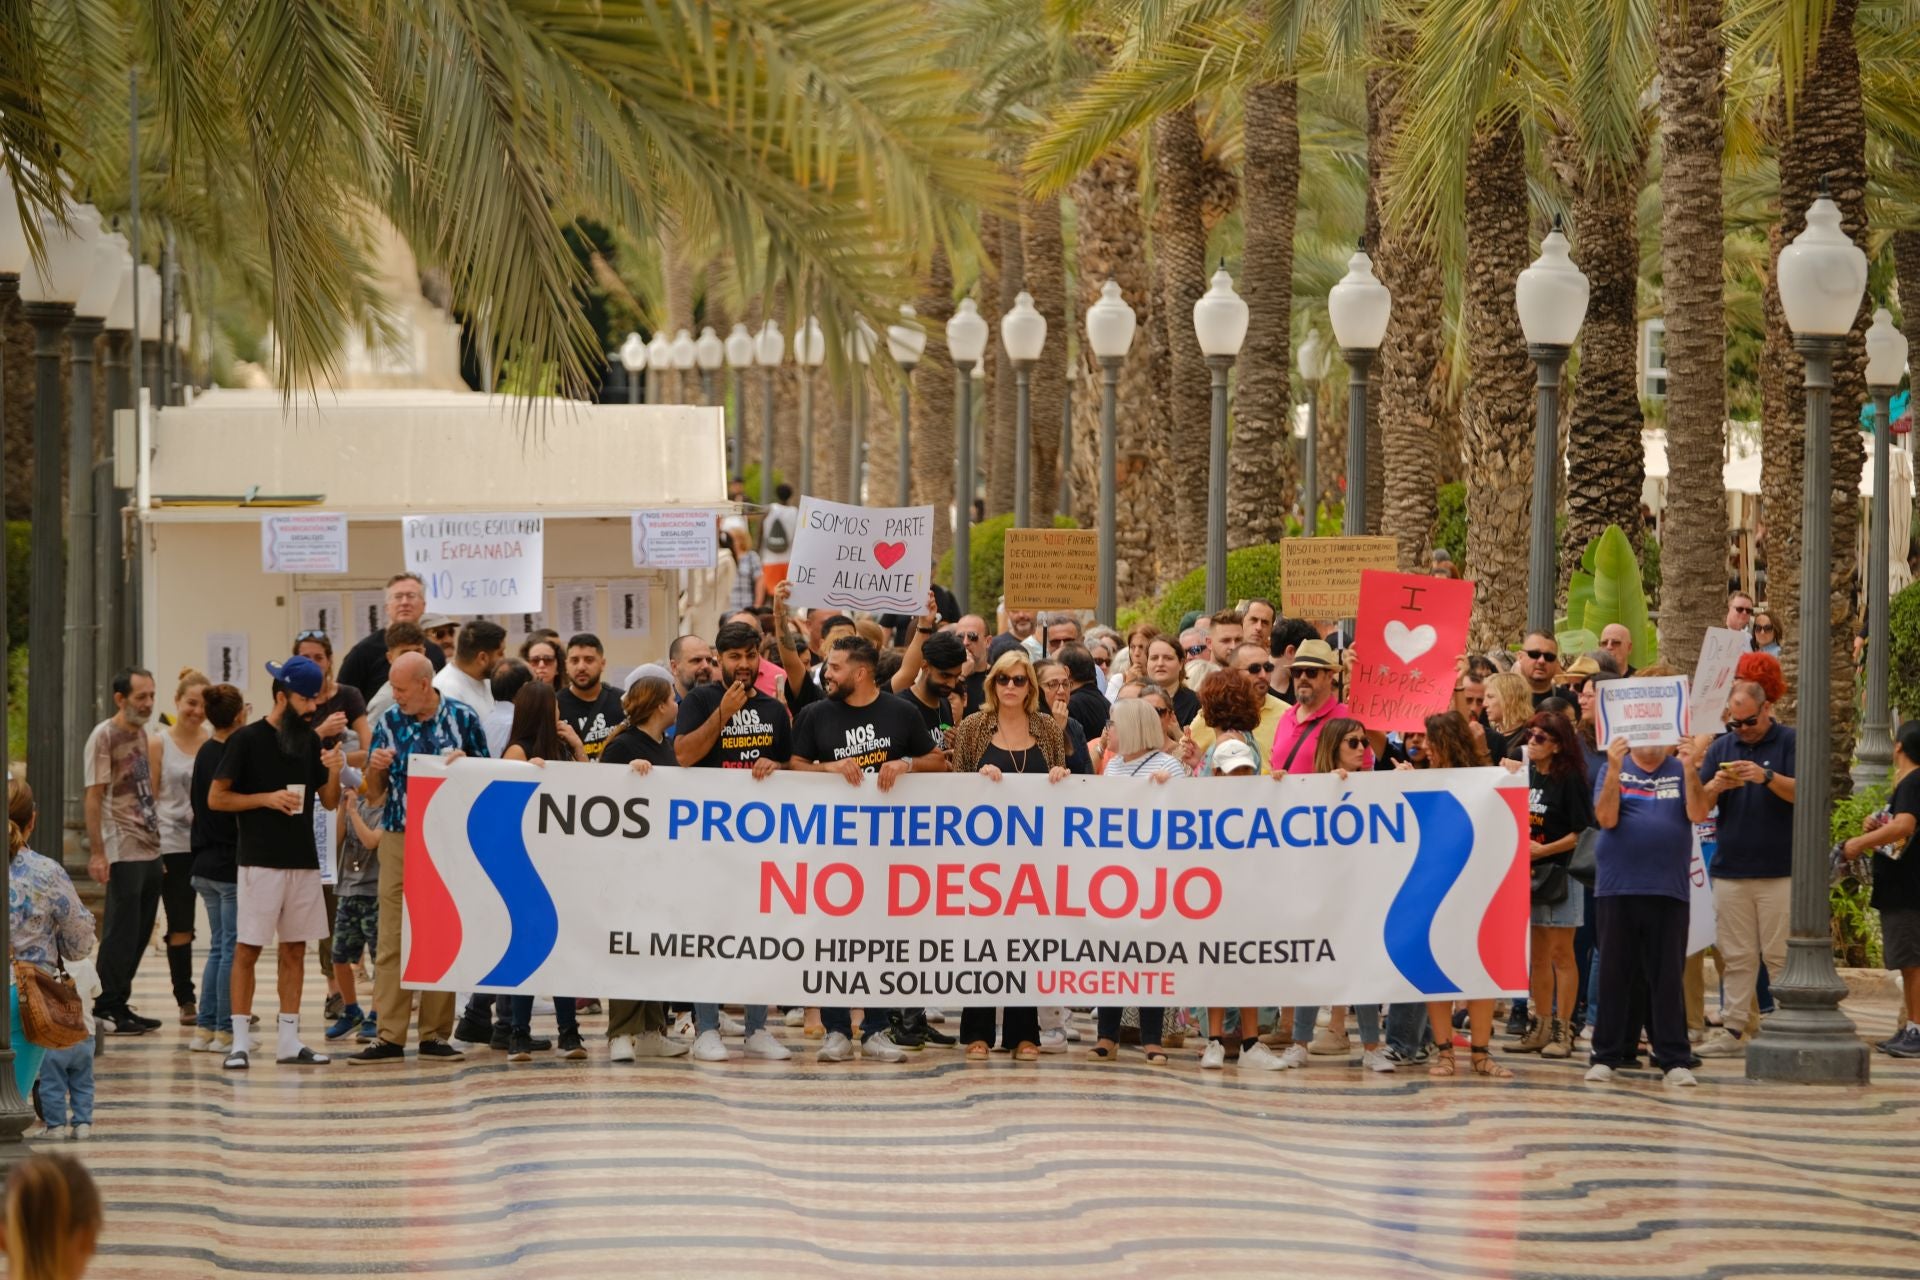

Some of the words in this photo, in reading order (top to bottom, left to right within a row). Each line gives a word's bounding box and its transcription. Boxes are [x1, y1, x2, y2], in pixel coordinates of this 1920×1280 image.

[885, 516, 925, 537] PARTE
[441, 541, 523, 560] EXPLANADA
[836, 545, 866, 562] DEL
[796, 565, 816, 585] DE
[461, 580, 478, 598] SE
[480, 577, 518, 597] TOCA
[1401, 585, 1427, 612] I
[732, 709, 760, 726] NOS
[721, 723, 774, 736] PROMETIERON
[845, 723, 876, 748] NOS
[722, 733, 773, 749] REUBICACIÓN
[833, 737, 891, 760] PROMETIERON
[740, 749, 760, 760] NO
[538, 793, 651, 839] NOS
[668, 799, 1045, 847] PROMETIERON
[1062, 792, 1407, 851] REUBICACIÓN
[759, 860, 865, 918] NO
[886, 861, 1224, 921] DESALOJO
[609, 930, 640, 956] EL
[650, 932, 805, 962] MERCADO
[815, 938, 910, 963] HIPPIE
[919, 939, 954, 963] DE
[963, 938, 998, 963] LA
[1007, 938, 1189, 964] EXPLANADA
[1198, 938, 1336, 965] NECESITA
[802, 970, 871, 995] UNA
[879, 970, 1027, 995] SOLUCION
[1036, 969, 1175, 996] URGENTE
